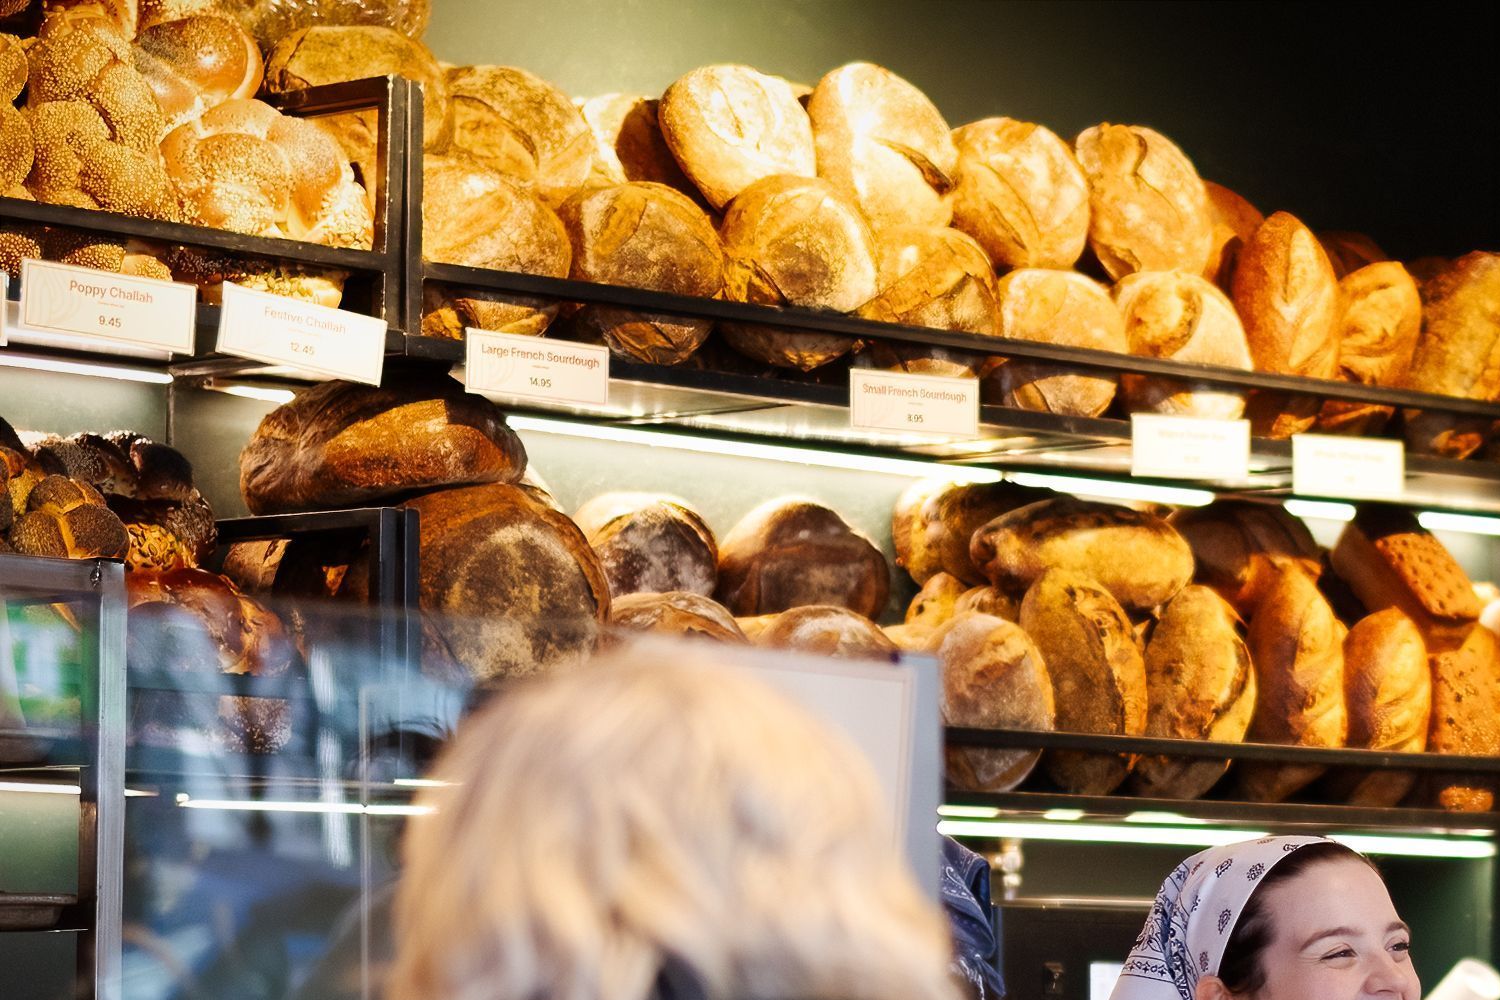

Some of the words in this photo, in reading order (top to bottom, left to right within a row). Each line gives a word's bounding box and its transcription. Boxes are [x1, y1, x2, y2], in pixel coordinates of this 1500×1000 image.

[69, 280, 107, 299] Poppy
[109, 286, 153, 303] Challah
[98, 315, 122, 328] 9.45
[264, 306, 302, 324] Festive
[306, 315, 346, 334] Challah
[481, 344, 509, 358] Large
[511, 347, 544, 361] French
[547, 352, 600, 370] Sourdough
[862, 383, 887, 395] Small
[888, 386, 918, 398] French
[920, 389, 967, 404] Sourdough
